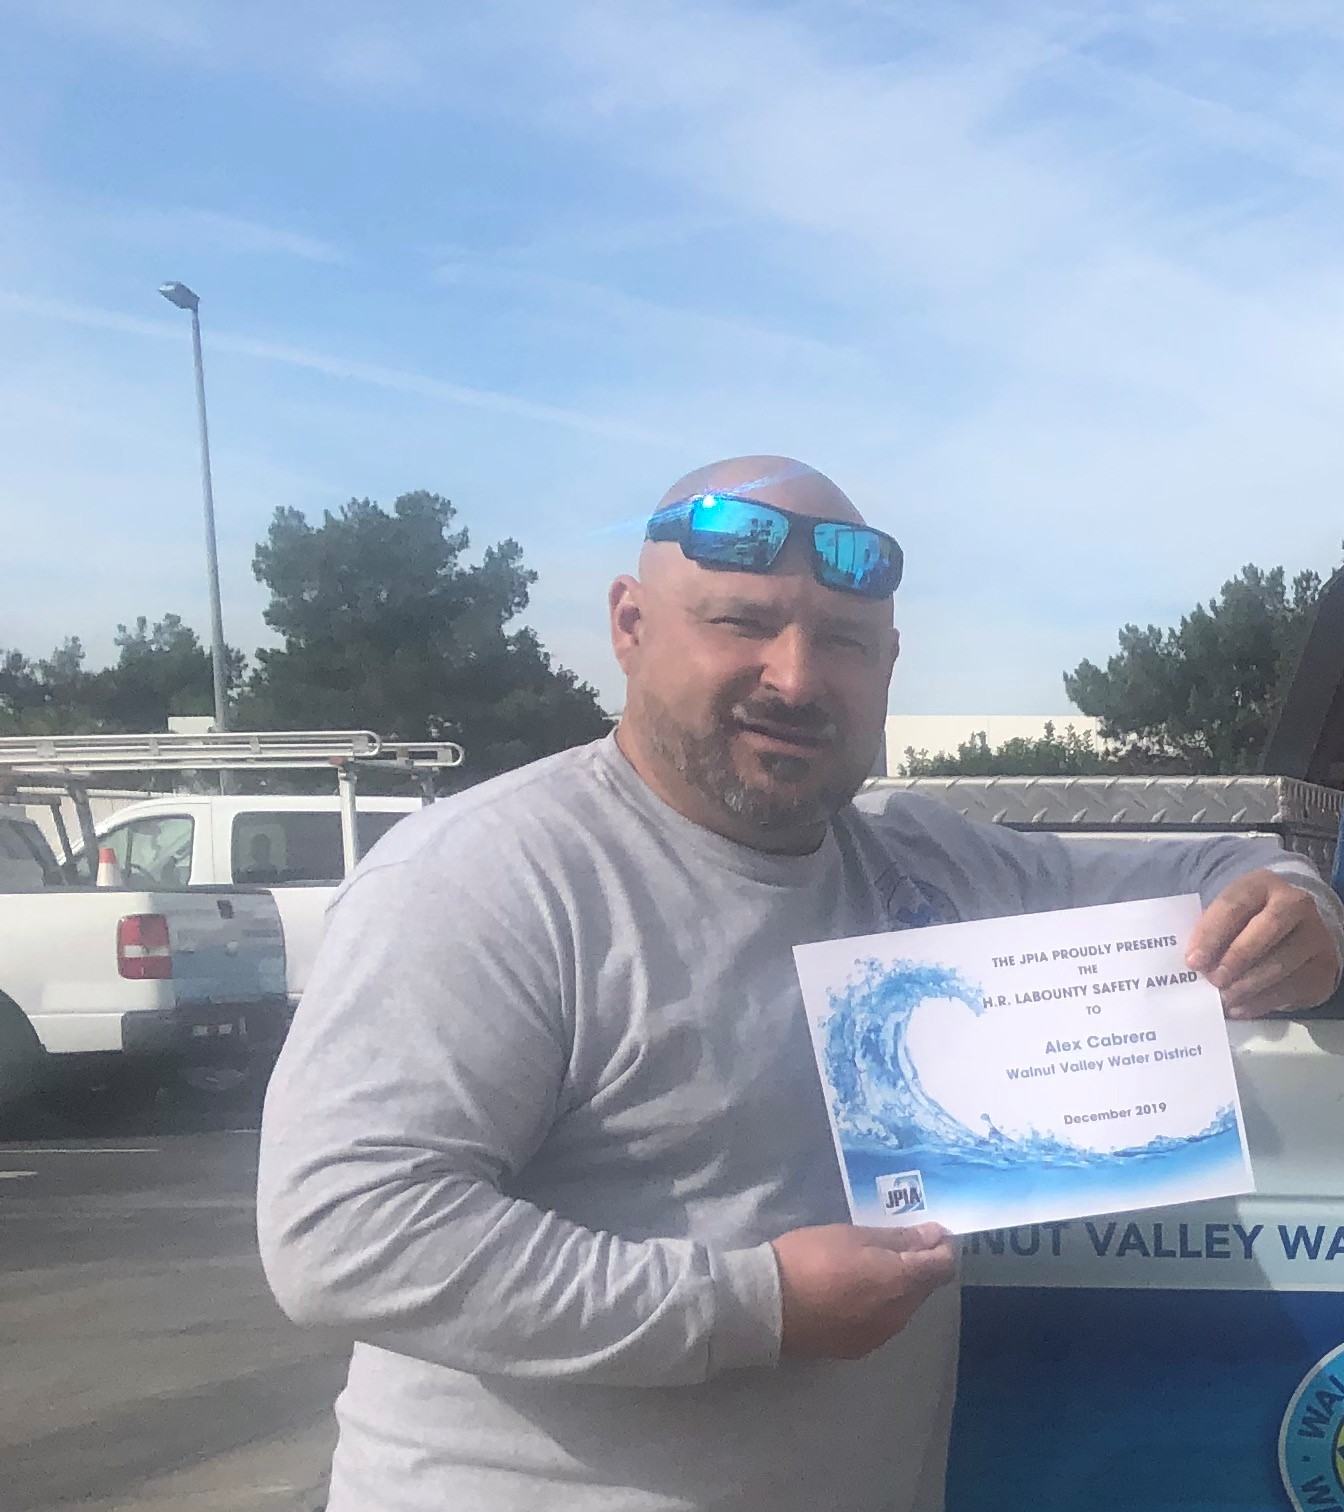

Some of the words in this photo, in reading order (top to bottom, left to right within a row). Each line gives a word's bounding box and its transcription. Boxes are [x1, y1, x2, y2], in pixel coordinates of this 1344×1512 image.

[992, 954, 1015, 968] THE
[1019, 951, 1048, 965] JPIA
[1052, 943, 1111, 961] PROUDLY
[1117, 935, 1177, 953] PRESENTS
[1078, 963, 1098, 976] THE
[982, 994, 1011, 1009] H.R.
[1015, 985, 1088, 1005] LABOUNTY
[1092, 978, 1140, 996] SAFETY
[1145, 971, 1198, 990] AWARD
[1086, 1004, 1102, 1016] TO
[1045, 1036, 1082, 1055] Alex
[1086, 1029, 1157, 1051] Cabrera
[1006, 1063, 1056, 1080] Walnut
[1060, 1056, 1104, 1076] Valley
[1108, 1051, 1150, 1069] Water
[1154, 1045, 1203, 1062] District
[1063, 1108, 1132, 1126] December
[1135, 1102, 1167, 1117] 2019
[886, 1188, 920, 1208] JPIA
[962, 1220, 1071, 1256] NUT
[1085, 1222, 1262, 1259] VALLEY
